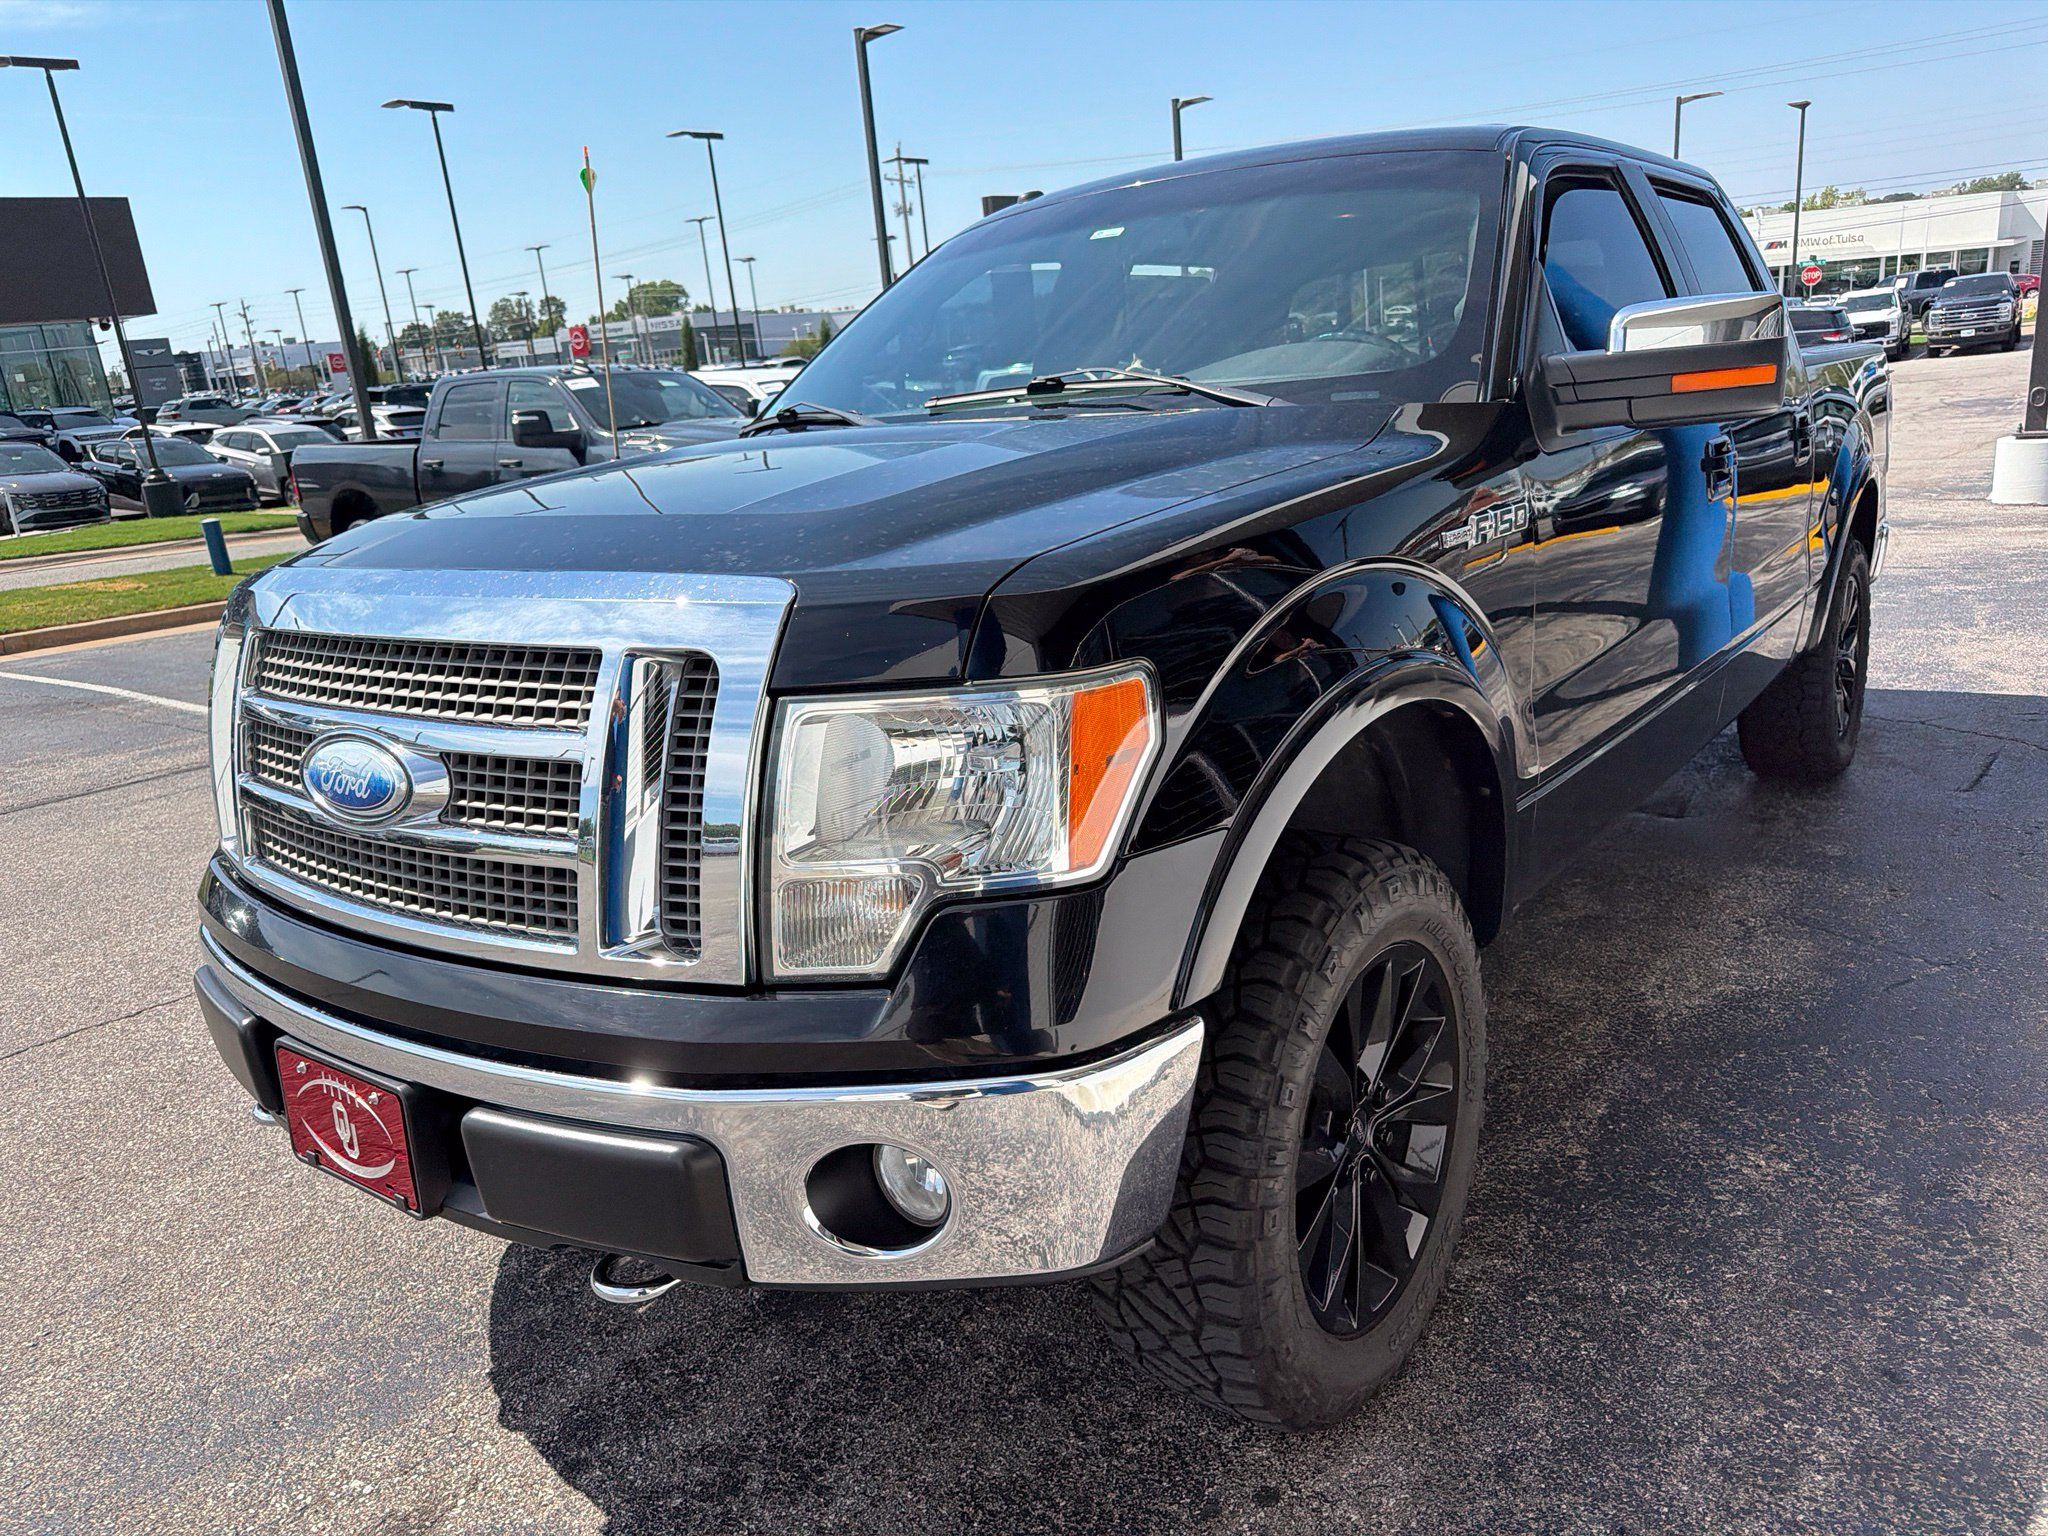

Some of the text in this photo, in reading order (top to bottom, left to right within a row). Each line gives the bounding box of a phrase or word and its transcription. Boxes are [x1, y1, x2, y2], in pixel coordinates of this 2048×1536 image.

[1796, 233, 1864, 248] MW of Tulsa
[1803, 271, 1821, 280] STOP
[650, 319, 682, 330] NISSA
[318, 755, 372, 799] Ford
